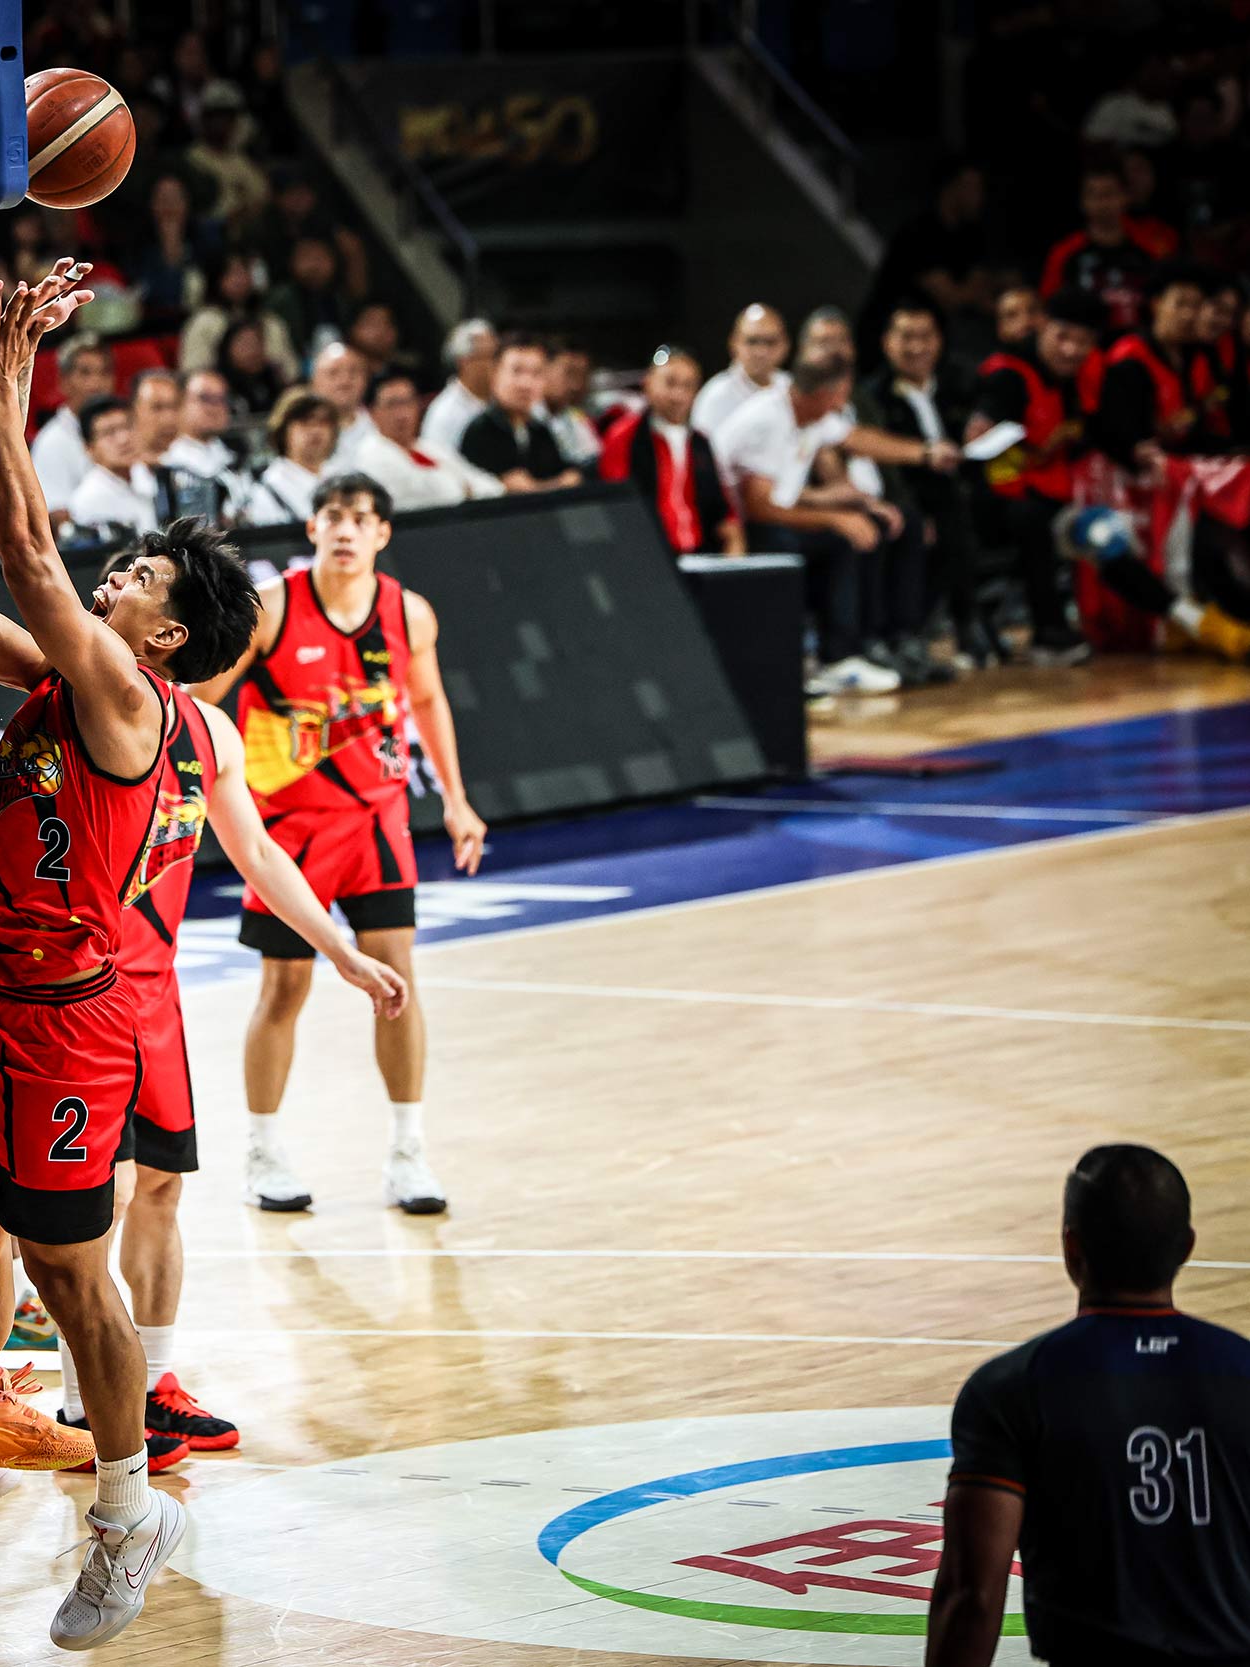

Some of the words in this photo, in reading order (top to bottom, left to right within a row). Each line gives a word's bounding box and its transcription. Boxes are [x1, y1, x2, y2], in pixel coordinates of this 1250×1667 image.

[34, 816, 72, 882] 2
[47, 1095, 89, 1162] 2
[1126, 1425, 1211, 1526] 31
